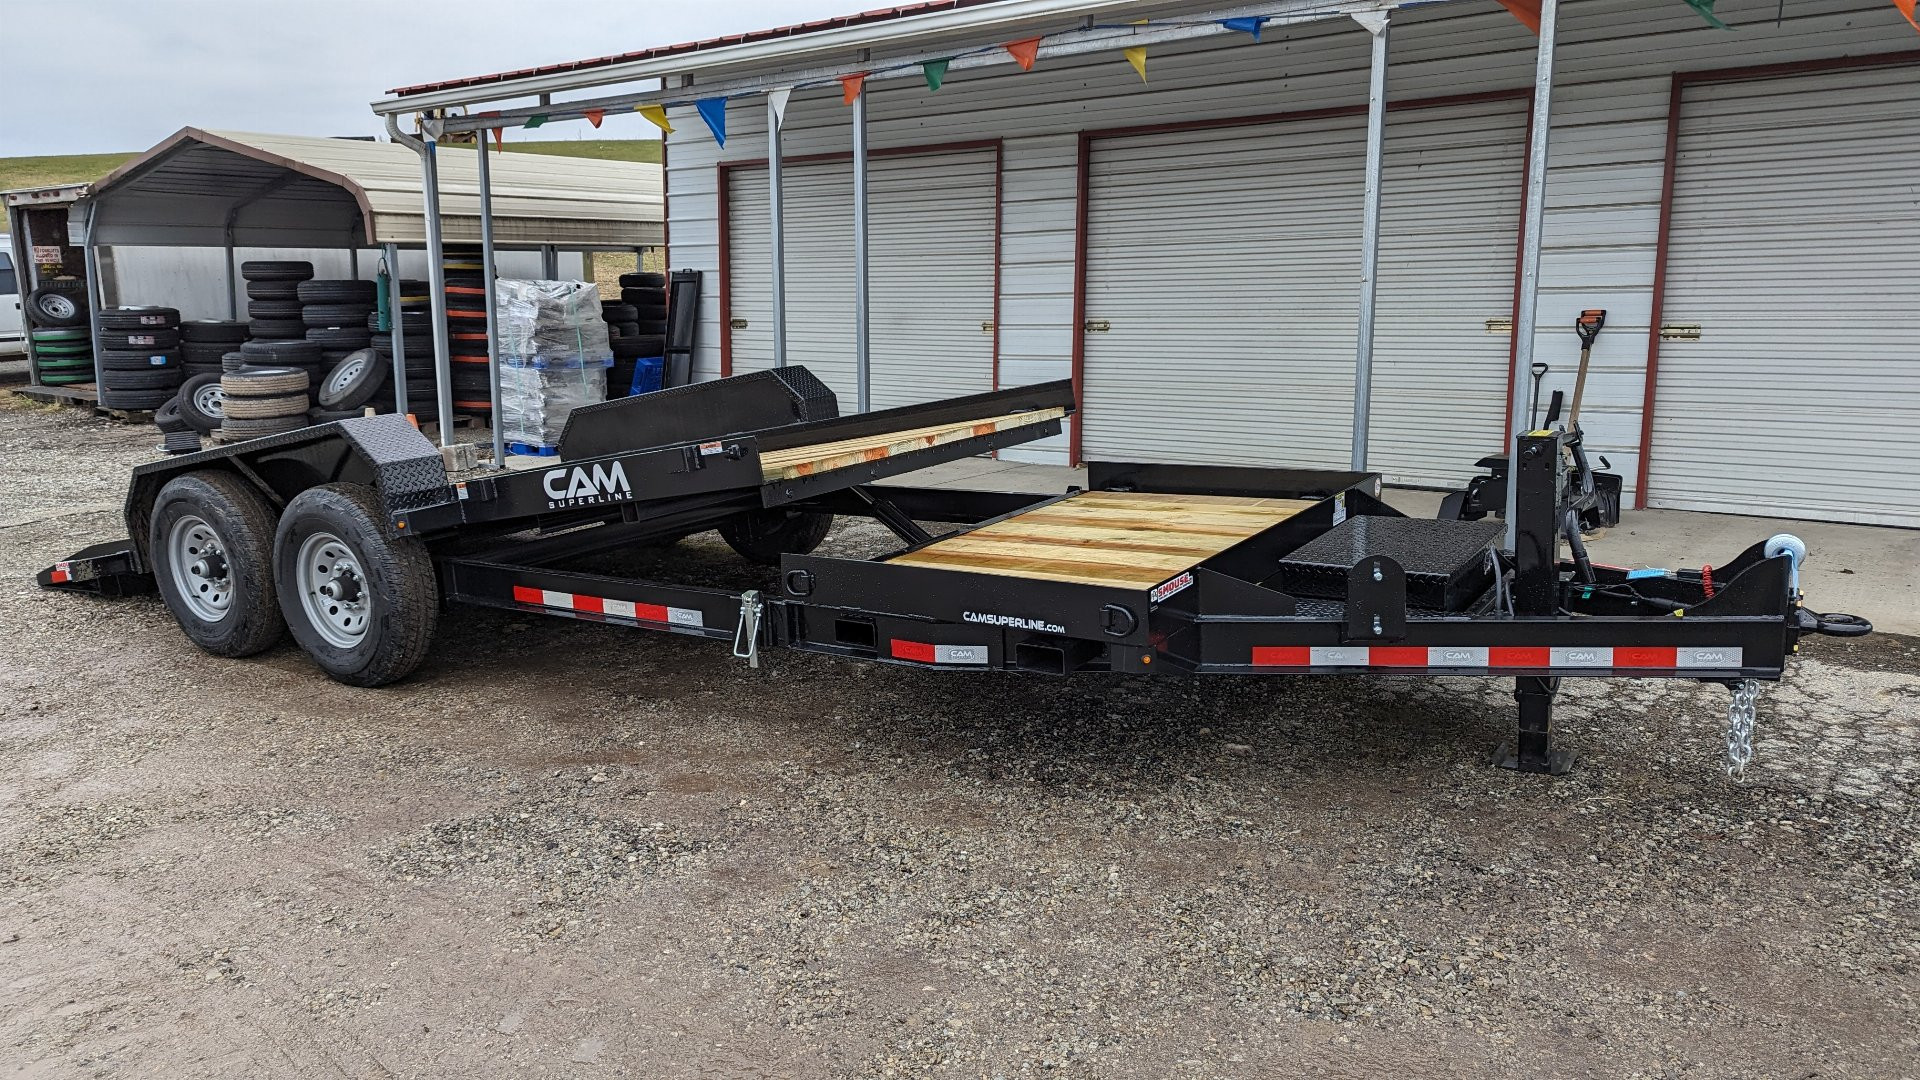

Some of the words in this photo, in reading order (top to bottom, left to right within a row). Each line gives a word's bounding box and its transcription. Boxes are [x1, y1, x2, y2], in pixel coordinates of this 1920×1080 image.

[543, 461, 631, 500] CAM
[548, 491, 633, 509] SUPERLINE
[1158, 574, 1190, 597] SMOUSE
[963, 611, 1066, 634] CAMSUPERLINE.COM
[950, 650, 972, 658] CAM
[1568, 651, 1594, 660] CAM
[1696, 651, 1723, 660] CAM
